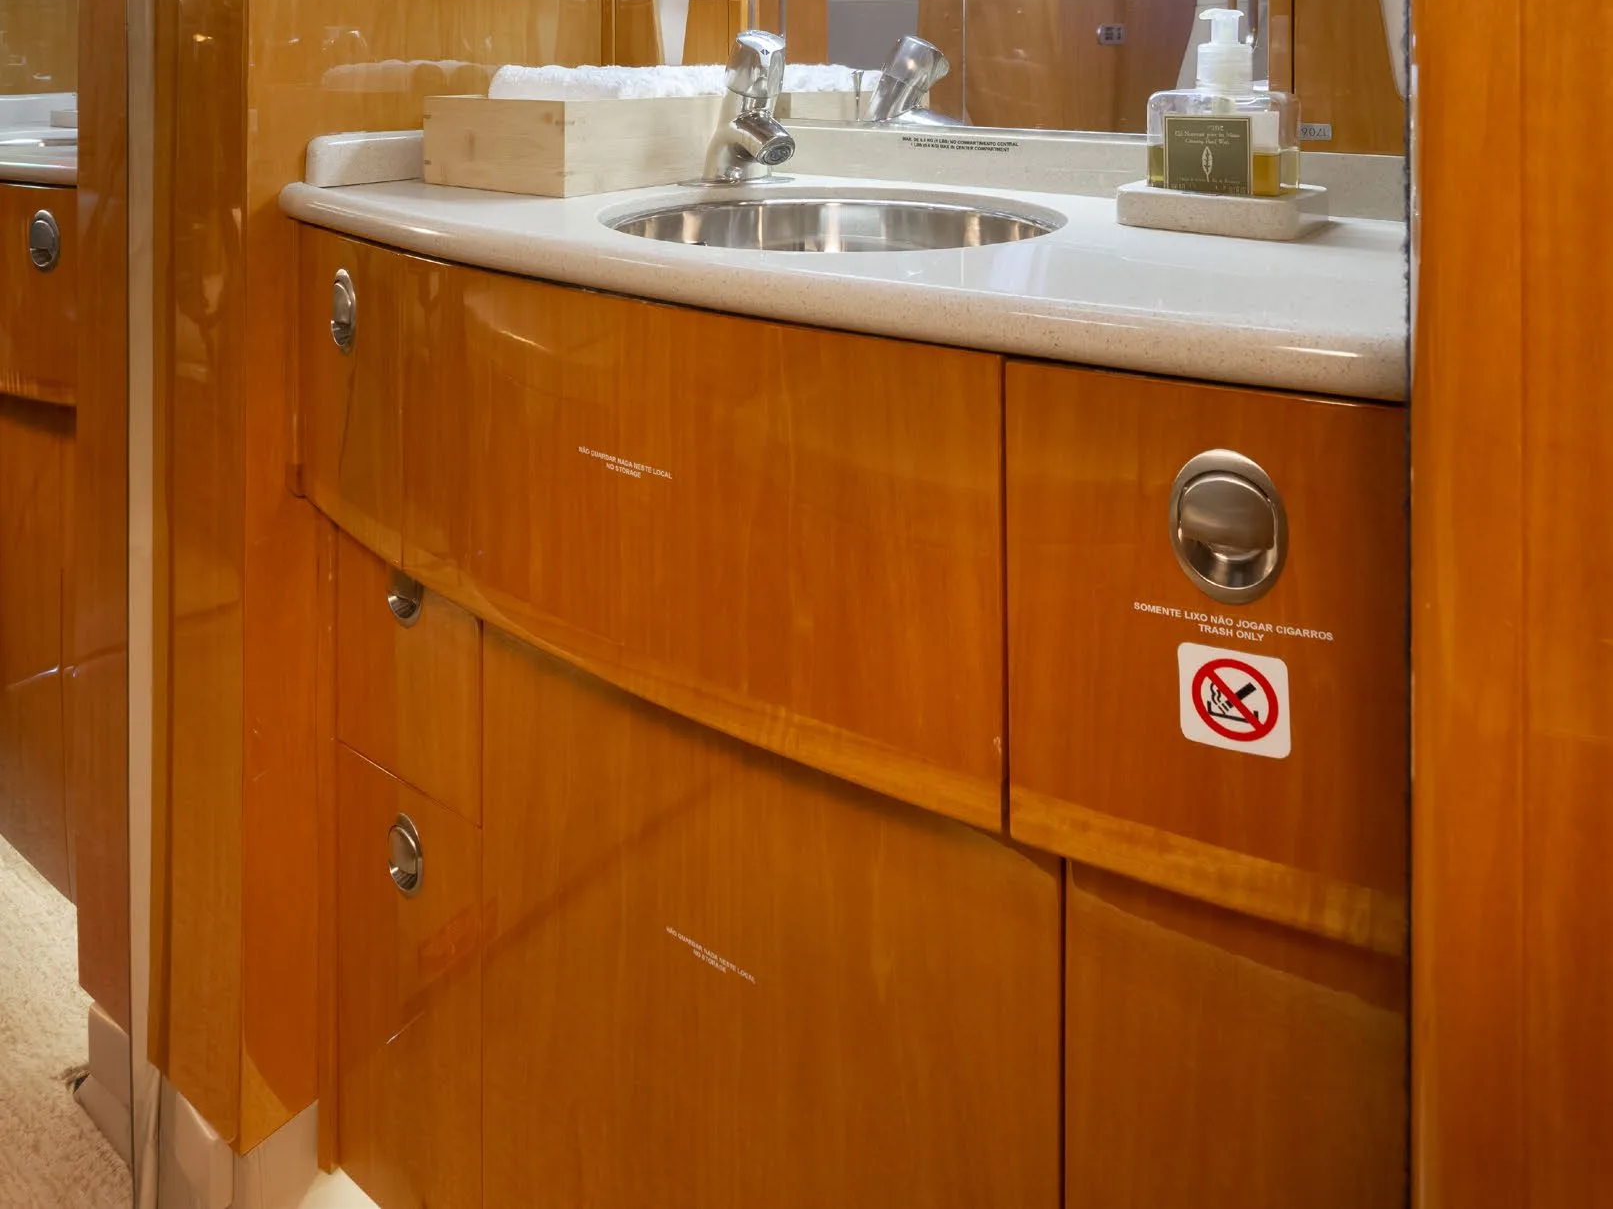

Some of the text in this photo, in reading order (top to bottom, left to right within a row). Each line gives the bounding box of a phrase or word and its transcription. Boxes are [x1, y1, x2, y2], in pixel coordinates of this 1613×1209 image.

[579, 446, 590, 455] NÃO
[615, 465, 641, 478] STORAGE
[1133, 601, 1334, 641] SOMENTE LIXO NÃO JOGAR CIGARROS
[1198, 623, 1264, 642] TRASH ONLY
